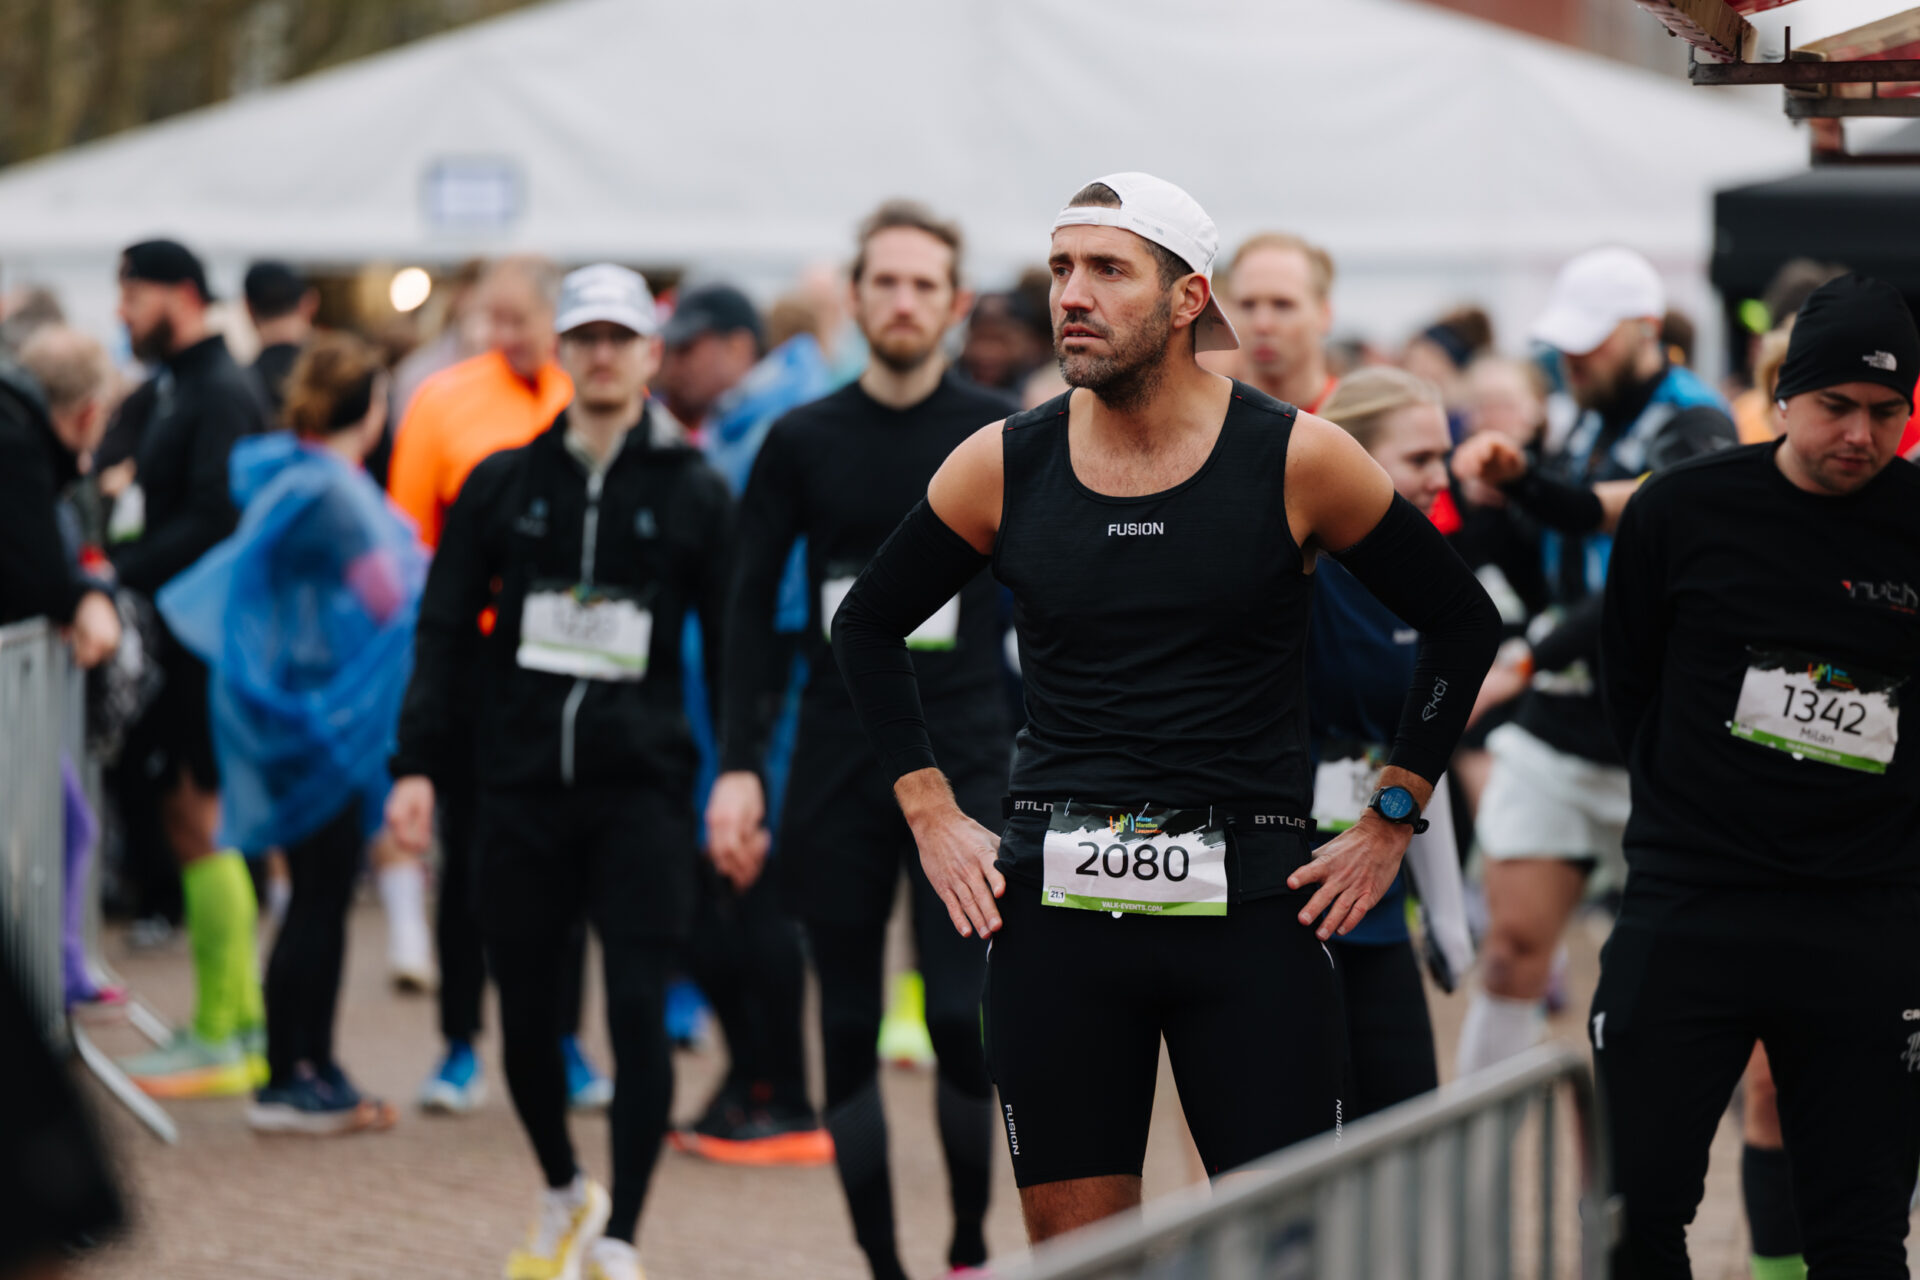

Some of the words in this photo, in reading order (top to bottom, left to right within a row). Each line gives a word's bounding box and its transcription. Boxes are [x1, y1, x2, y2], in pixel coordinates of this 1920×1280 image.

[1107, 522, 1164, 536] FUSION
[1783, 684, 1867, 736] 1342
[1800, 726, 1835, 745] Milan
[1014, 800, 1054, 812] BTTLN
[1075, 841, 1190, 882] 2080
[1050, 890, 1065, 899] 21.1
[1101, 900, 1163, 913] VALK-EVENTS.COM
[1005, 1104, 1020, 1155] FUSION
